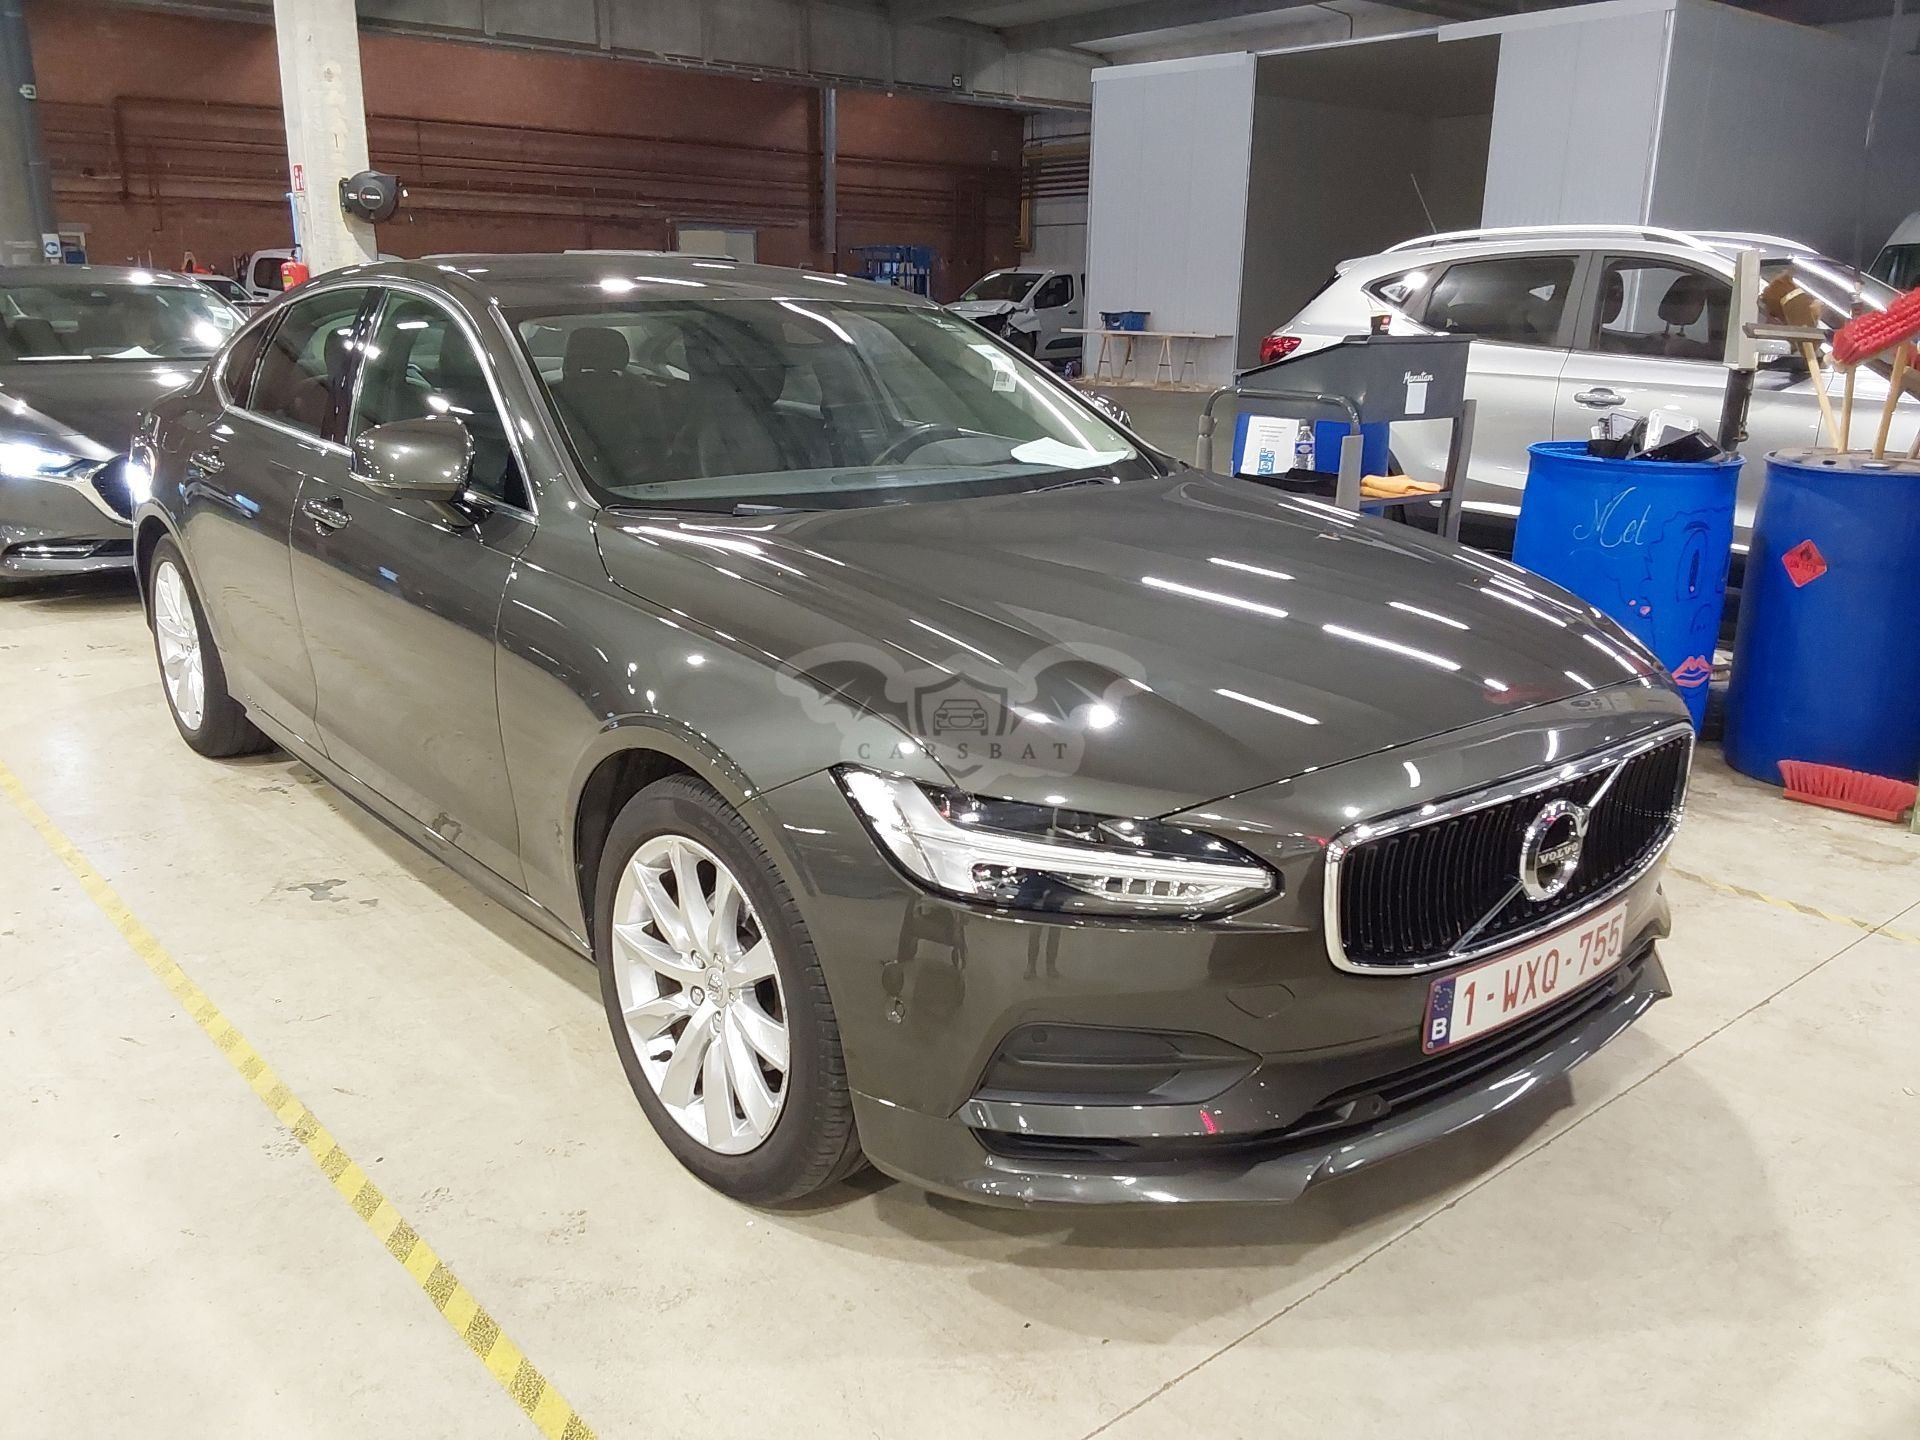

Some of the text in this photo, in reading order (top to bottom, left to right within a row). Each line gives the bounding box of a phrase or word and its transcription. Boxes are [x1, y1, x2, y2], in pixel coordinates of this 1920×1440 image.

[1539, 842, 1579, 864] VOLVO
[1463, 914, 1623, 1026] 1-WXQ-755
[1432, 1018, 1447, 1040] B
